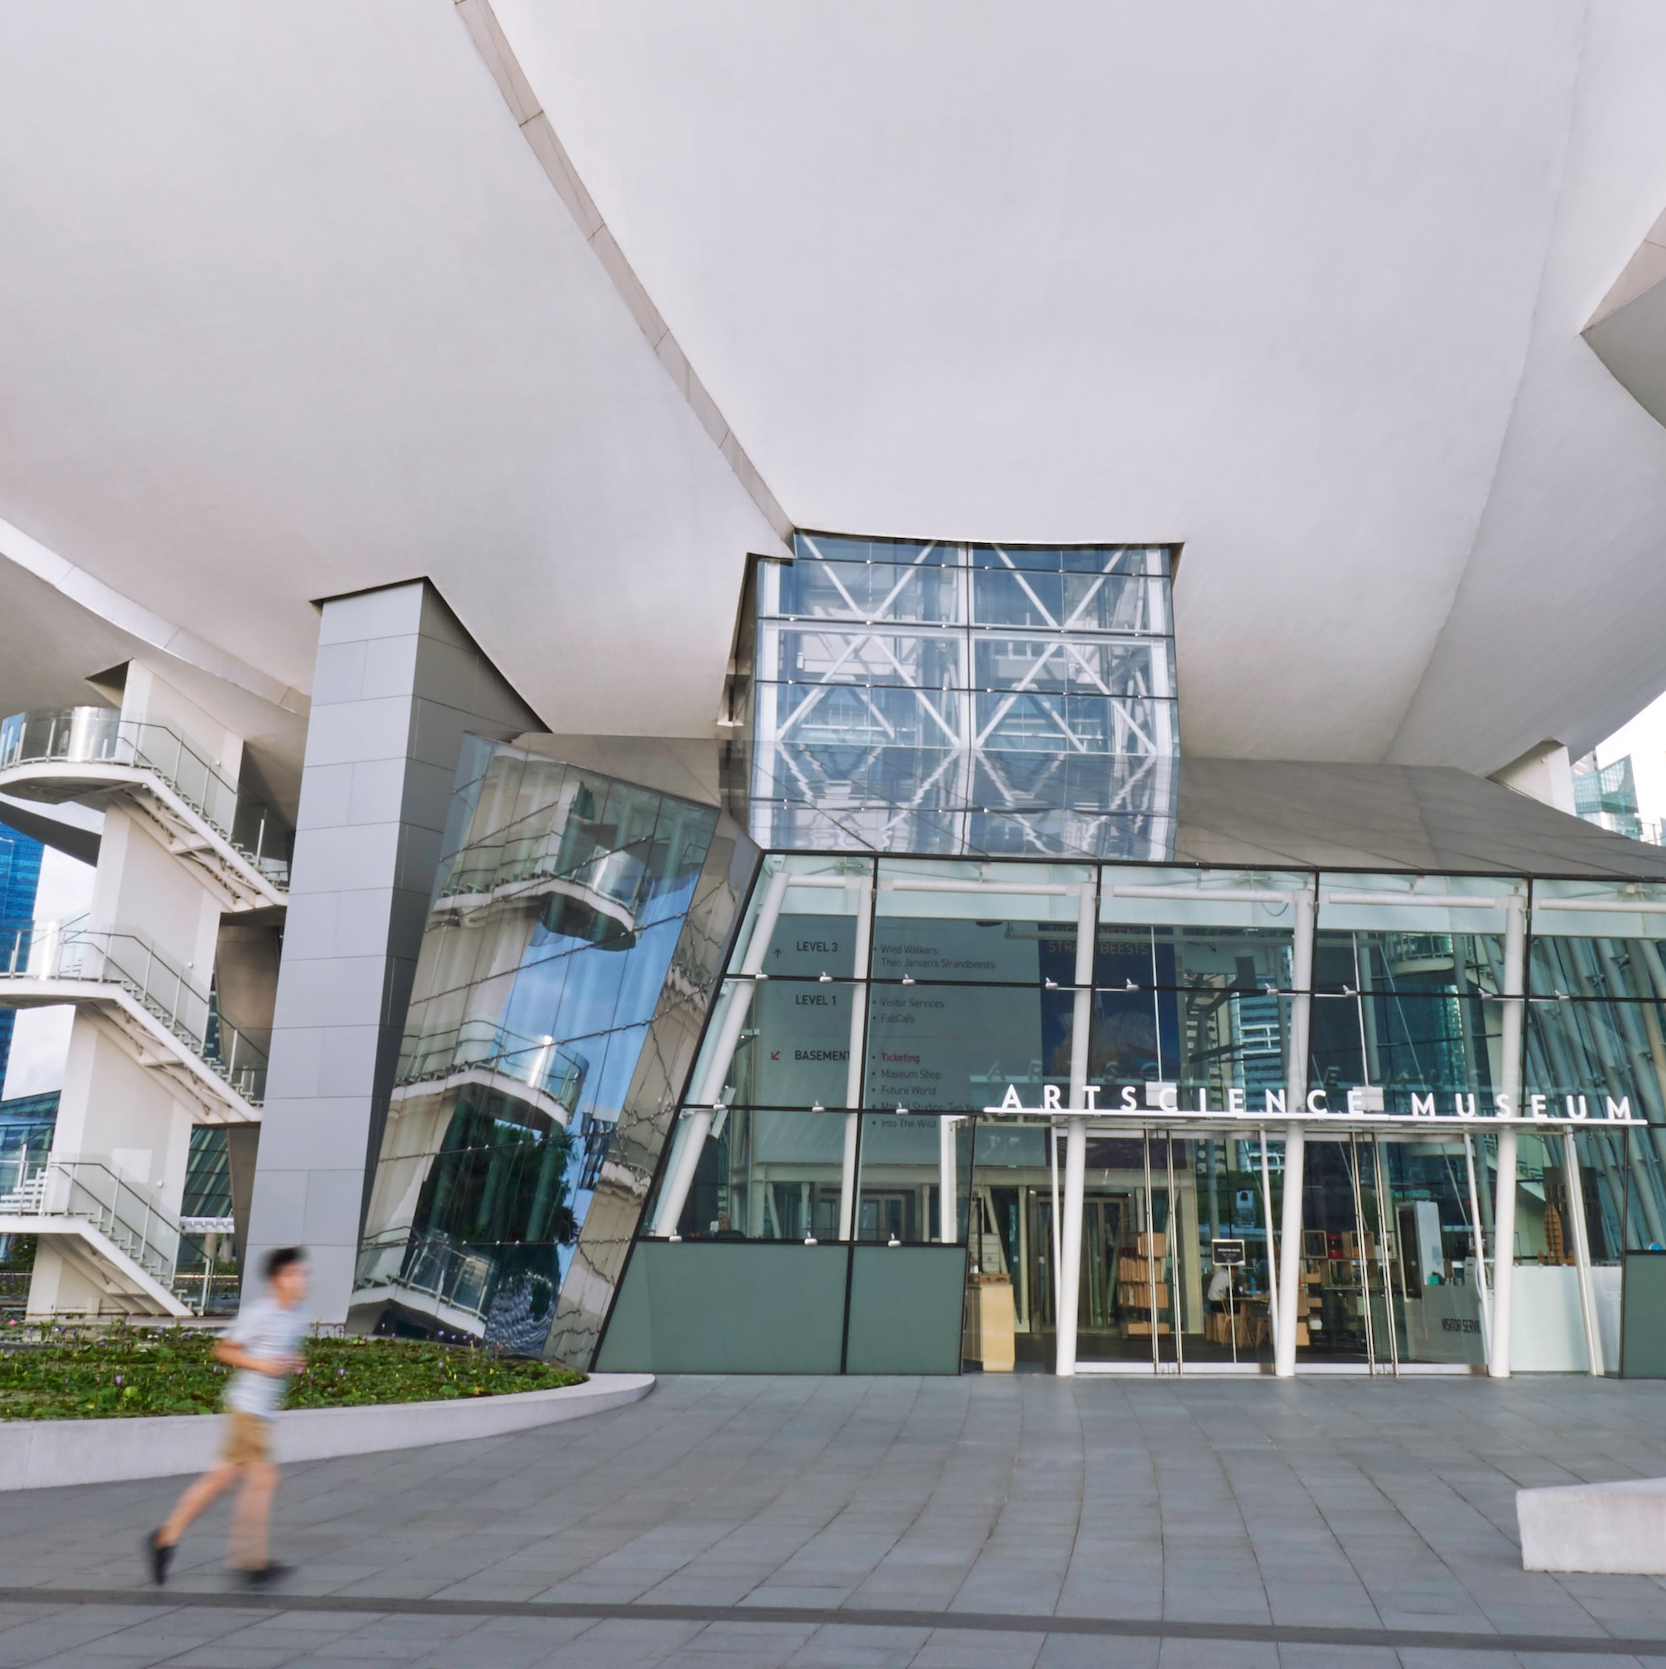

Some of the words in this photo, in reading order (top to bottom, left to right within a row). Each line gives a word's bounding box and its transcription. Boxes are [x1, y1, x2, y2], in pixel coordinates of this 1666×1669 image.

[796, 941, 830, 953] LEVEL
[831, 942, 838, 953] 3
[1048, 941, 1148, 955] STRBEESTS
[882, 957, 902, 968] Theo
[904, 958, 939, 968] Jansen's
[940, 958, 996, 969] Strandbeests
[795, 995, 829, 1006] LEVEL
[831, 995, 837, 1006] 1
[881, 998, 907, 1007] Visitor
[909, 998, 945, 1008] Services
[881, 1052, 921, 1065] Ticketing
[881, 1069, 918, 1079] Museum
[919, 1069, 942, 1081] Shop
[881, 1085, 909, 1095] Future
[911, 1086, 937, 1095] World
[1002, 1083, 1364, 1114] ARTSCIENCE
[1411, 1092, 1631, 1119] MUSEUM
[881, 1119, 897, 1128] Into
[899, 1119, 916, 1128] The
[917, 1119, 937, 1128] Wild
[1462, 1319, 1481, 1334] SERVI
